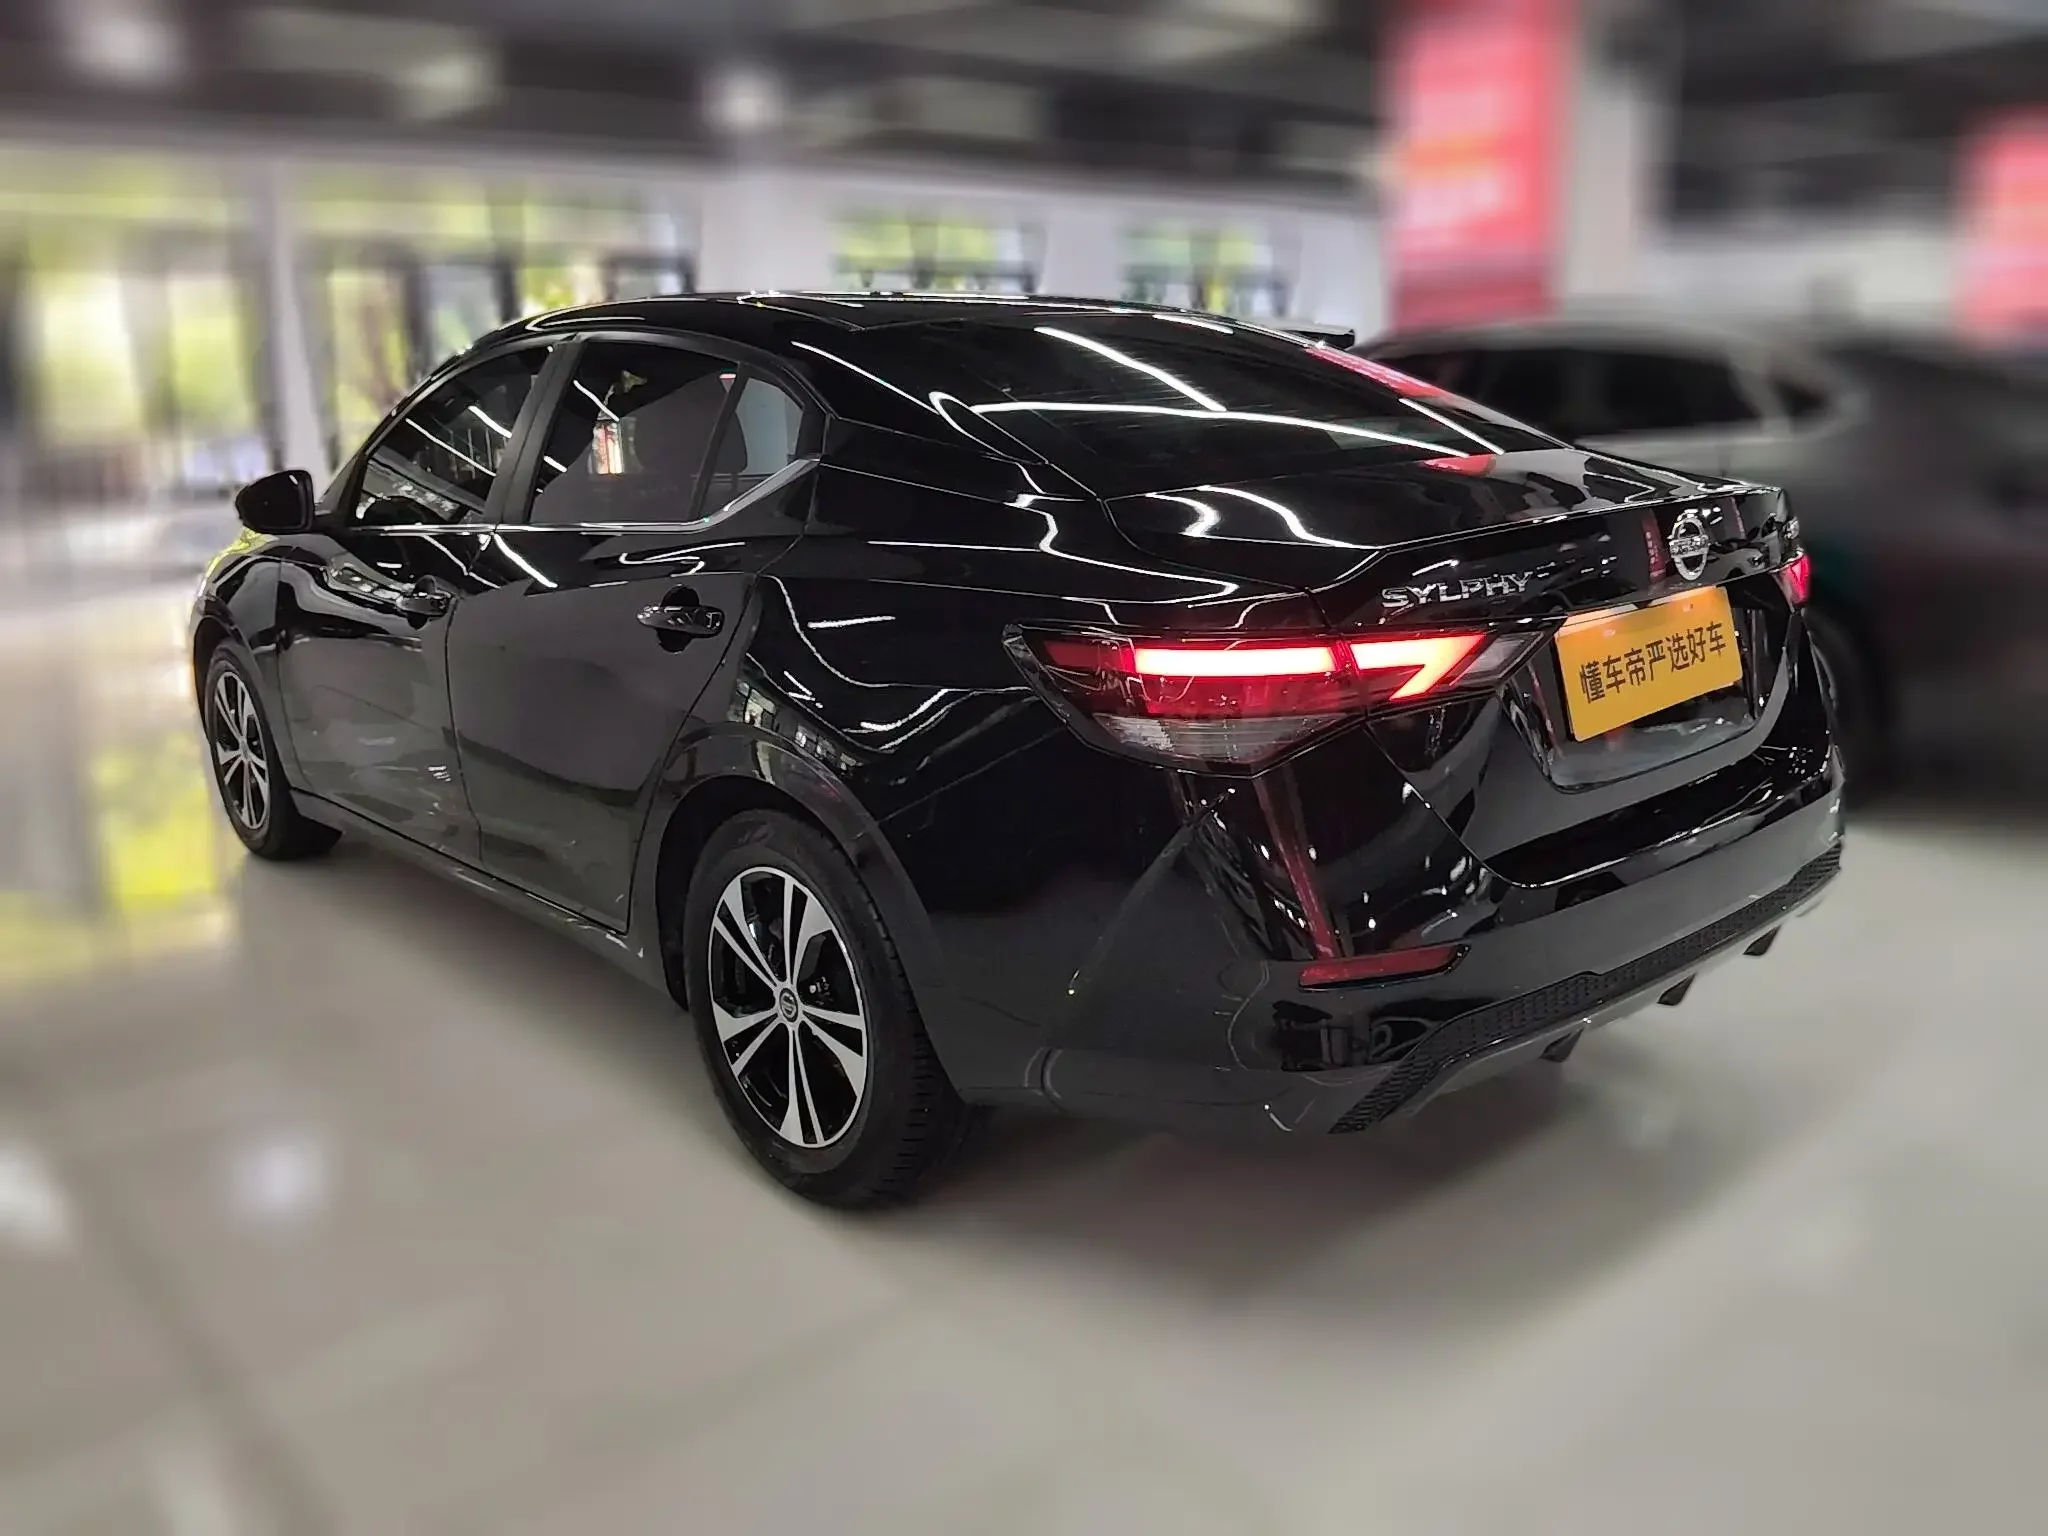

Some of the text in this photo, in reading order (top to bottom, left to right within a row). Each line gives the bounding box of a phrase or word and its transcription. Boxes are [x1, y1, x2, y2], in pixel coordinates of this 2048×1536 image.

[1381, 571, 1534, 608] SYLPHY
[1579, 621, 1727, 704] 懂车帝严选好车
